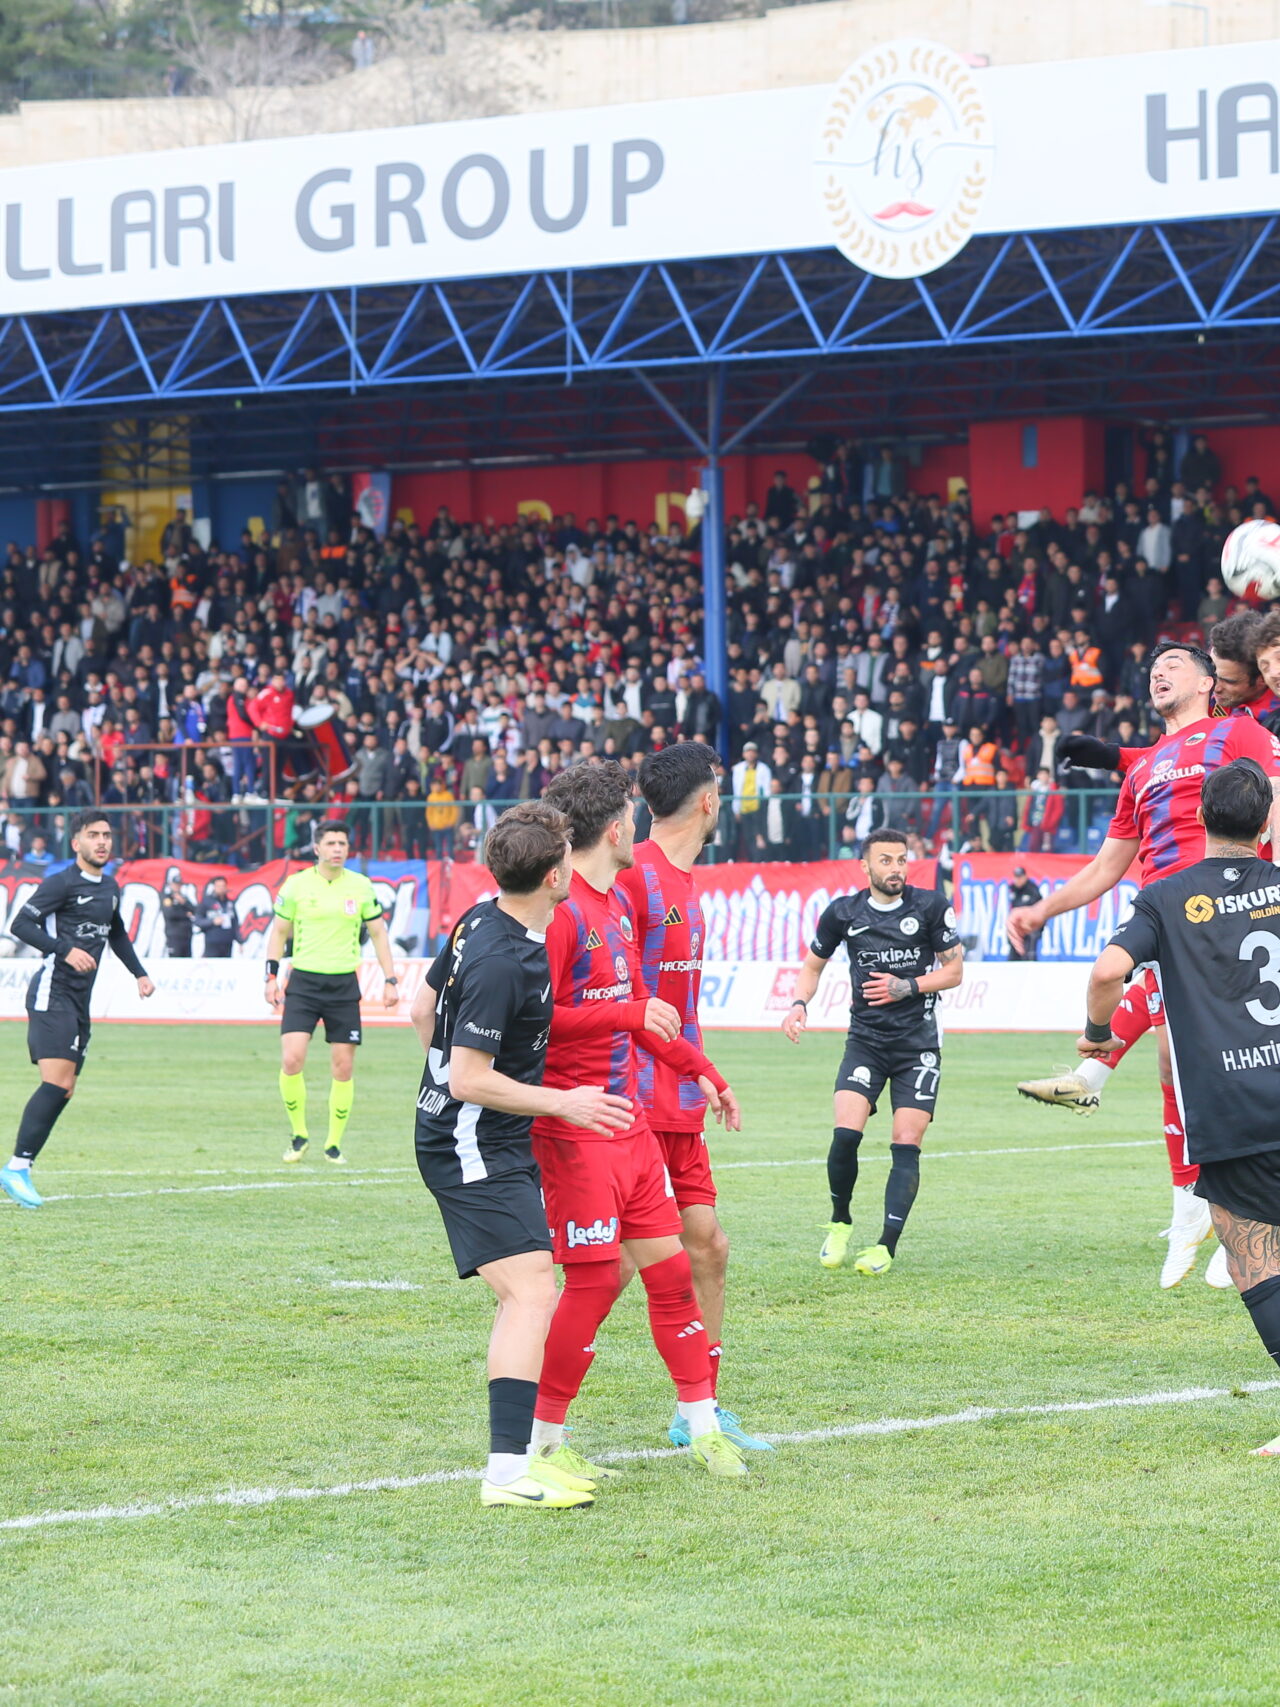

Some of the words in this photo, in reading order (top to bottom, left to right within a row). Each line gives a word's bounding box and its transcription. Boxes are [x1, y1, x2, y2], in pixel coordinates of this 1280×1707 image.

[294, 138, 665, 253] GROUP
[880, 947, 922, 964] KİPAŞ
[912, 1066, 940, 1094] 77
